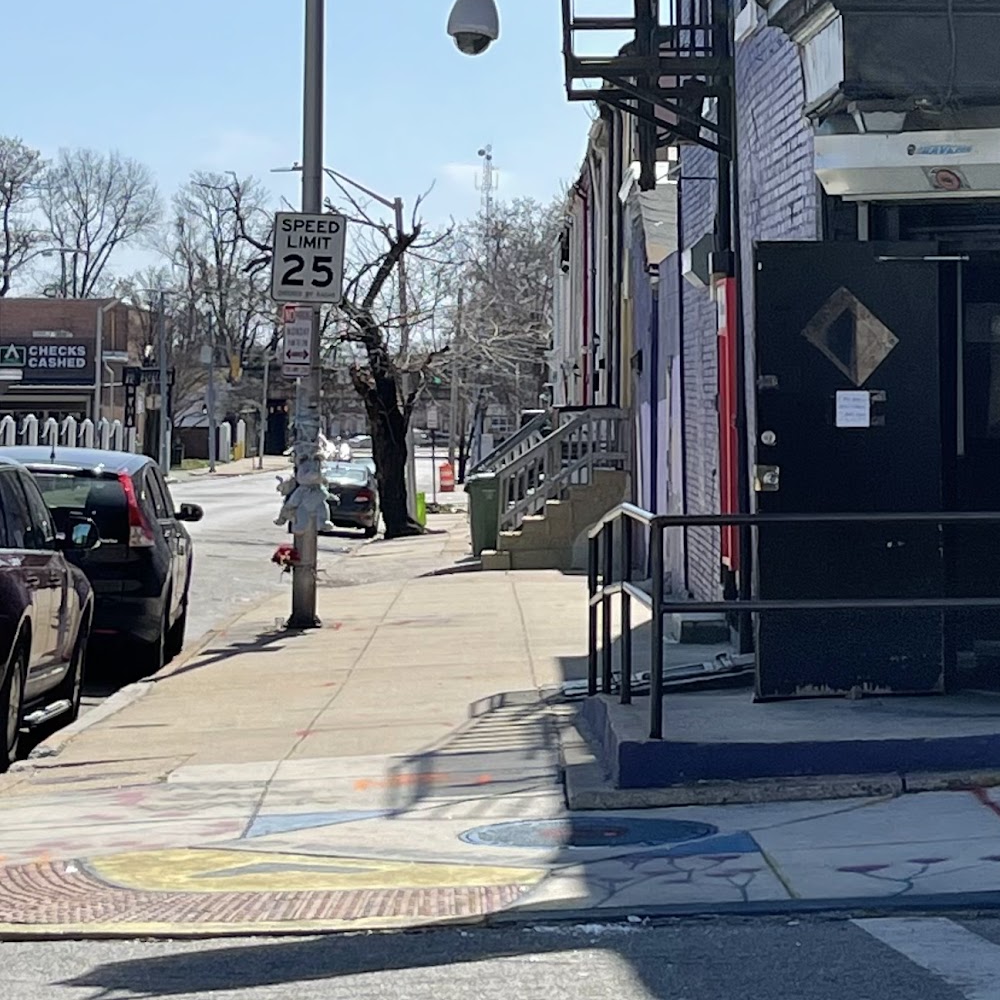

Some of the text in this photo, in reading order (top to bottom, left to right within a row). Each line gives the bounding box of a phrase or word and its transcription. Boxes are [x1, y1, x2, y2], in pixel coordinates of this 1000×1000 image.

[282, 219, 340, 234] SPEED
[287, 236, 332, 250] LIMIT
[281, 254, 334, 288] 25
[28, 346, 86, 356] CHECKS
[28, 357, 86, 368] CASHED
